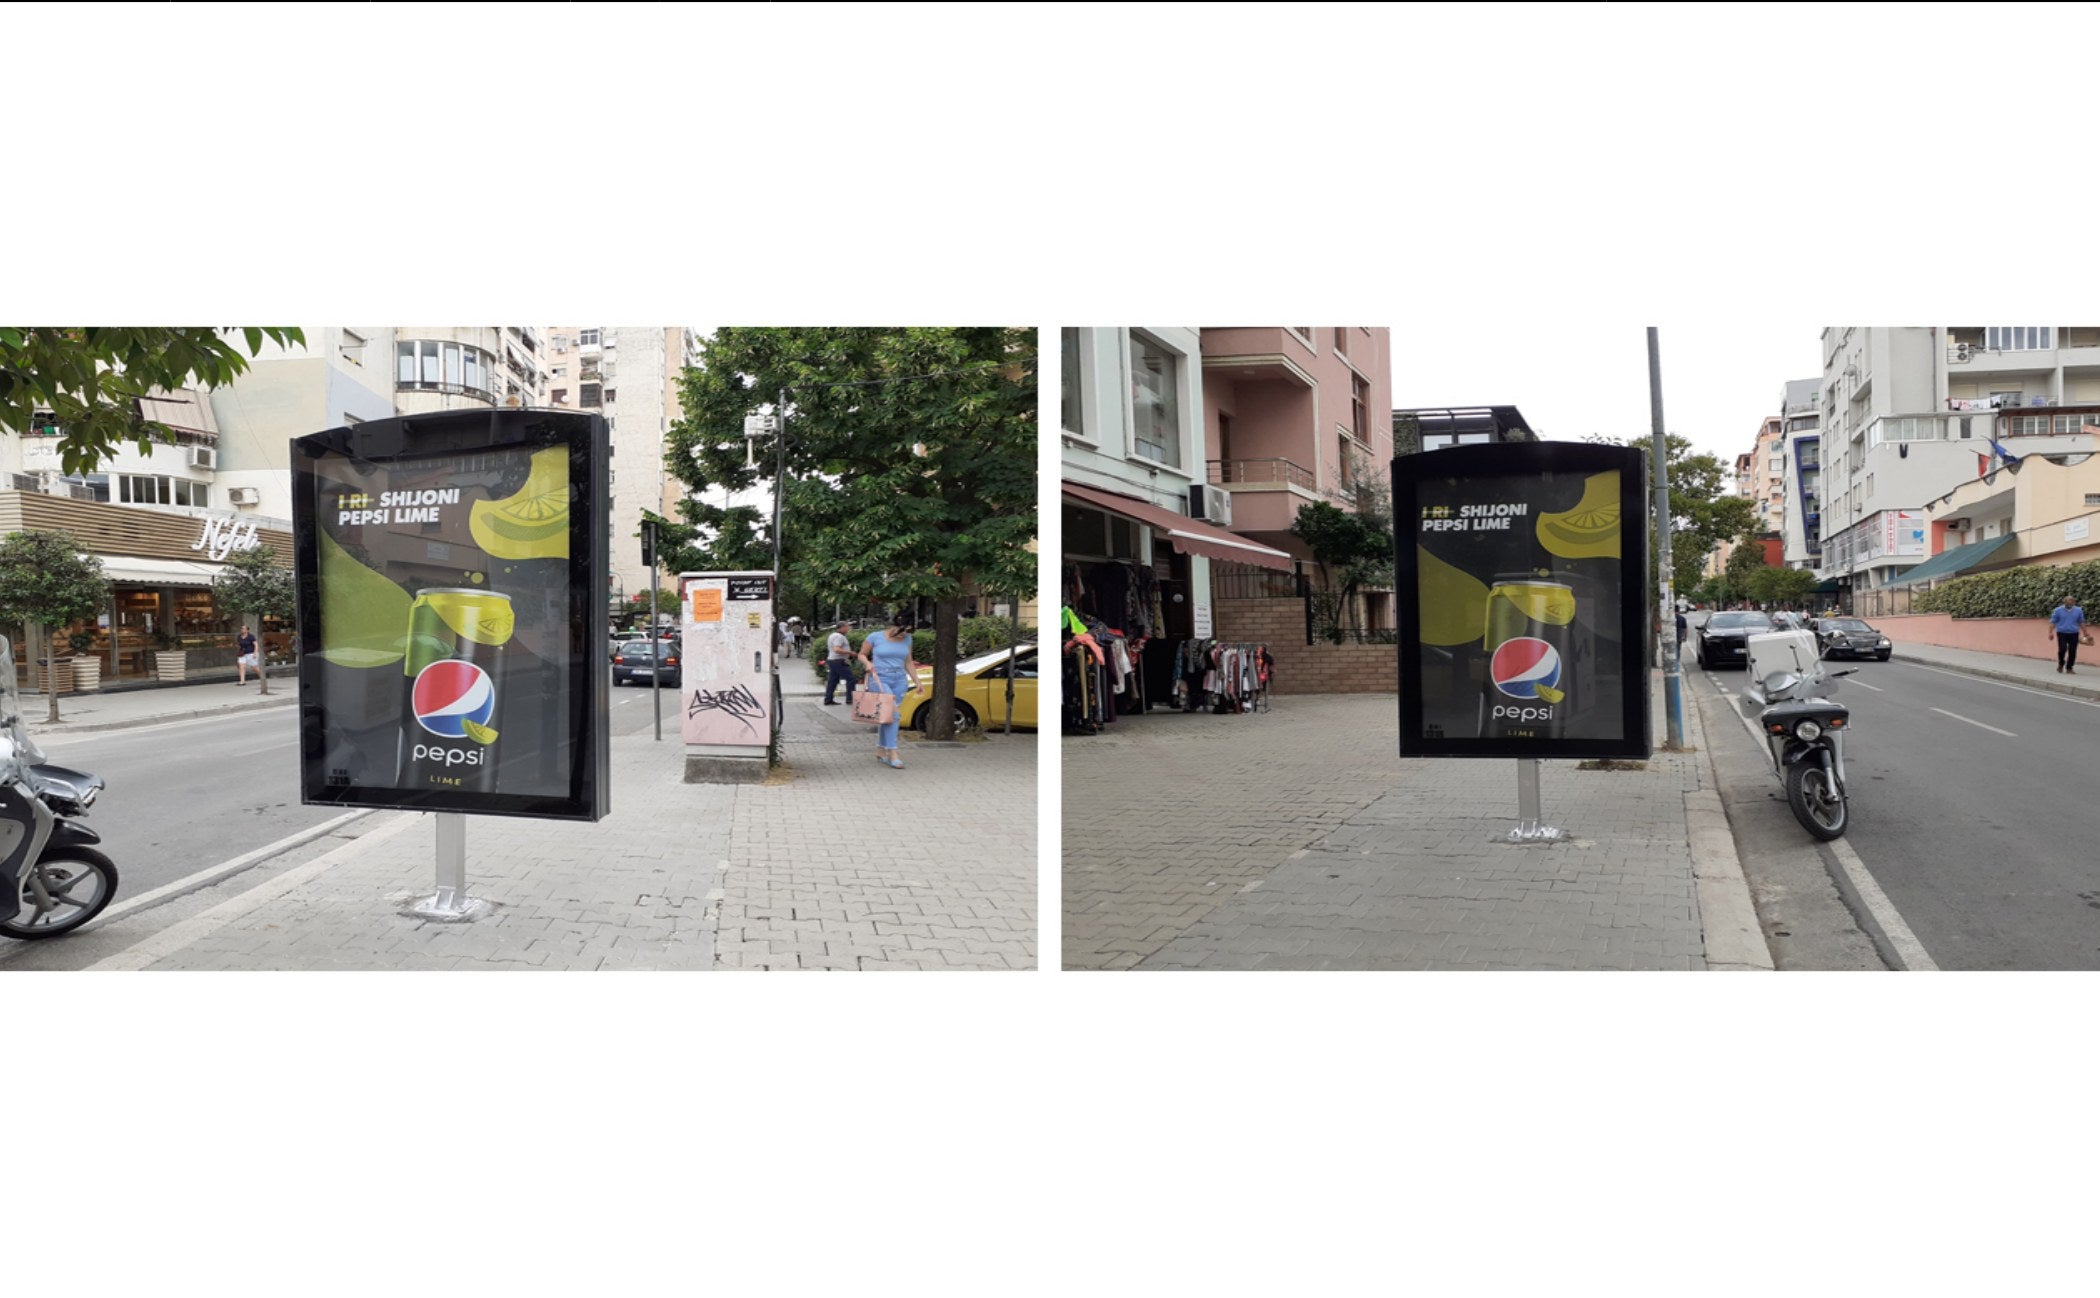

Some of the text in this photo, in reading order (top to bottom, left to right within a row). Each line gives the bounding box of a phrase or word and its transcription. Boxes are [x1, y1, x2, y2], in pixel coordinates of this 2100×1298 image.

[379, 488, 460, 507] SHIJONI
[338, 507, 440, 526] PEPSI LIME
[1459, 503, 1528, 517] SHIJONI
[1422, 517, 1511, 532] PEPSI LIME
[1492, 705, 1554, 723] pepsi
[1507, 729, 1535, 737] LIME
[411, 743, 485, 767] pepsi
[429, 775, 462, 786] LIME
